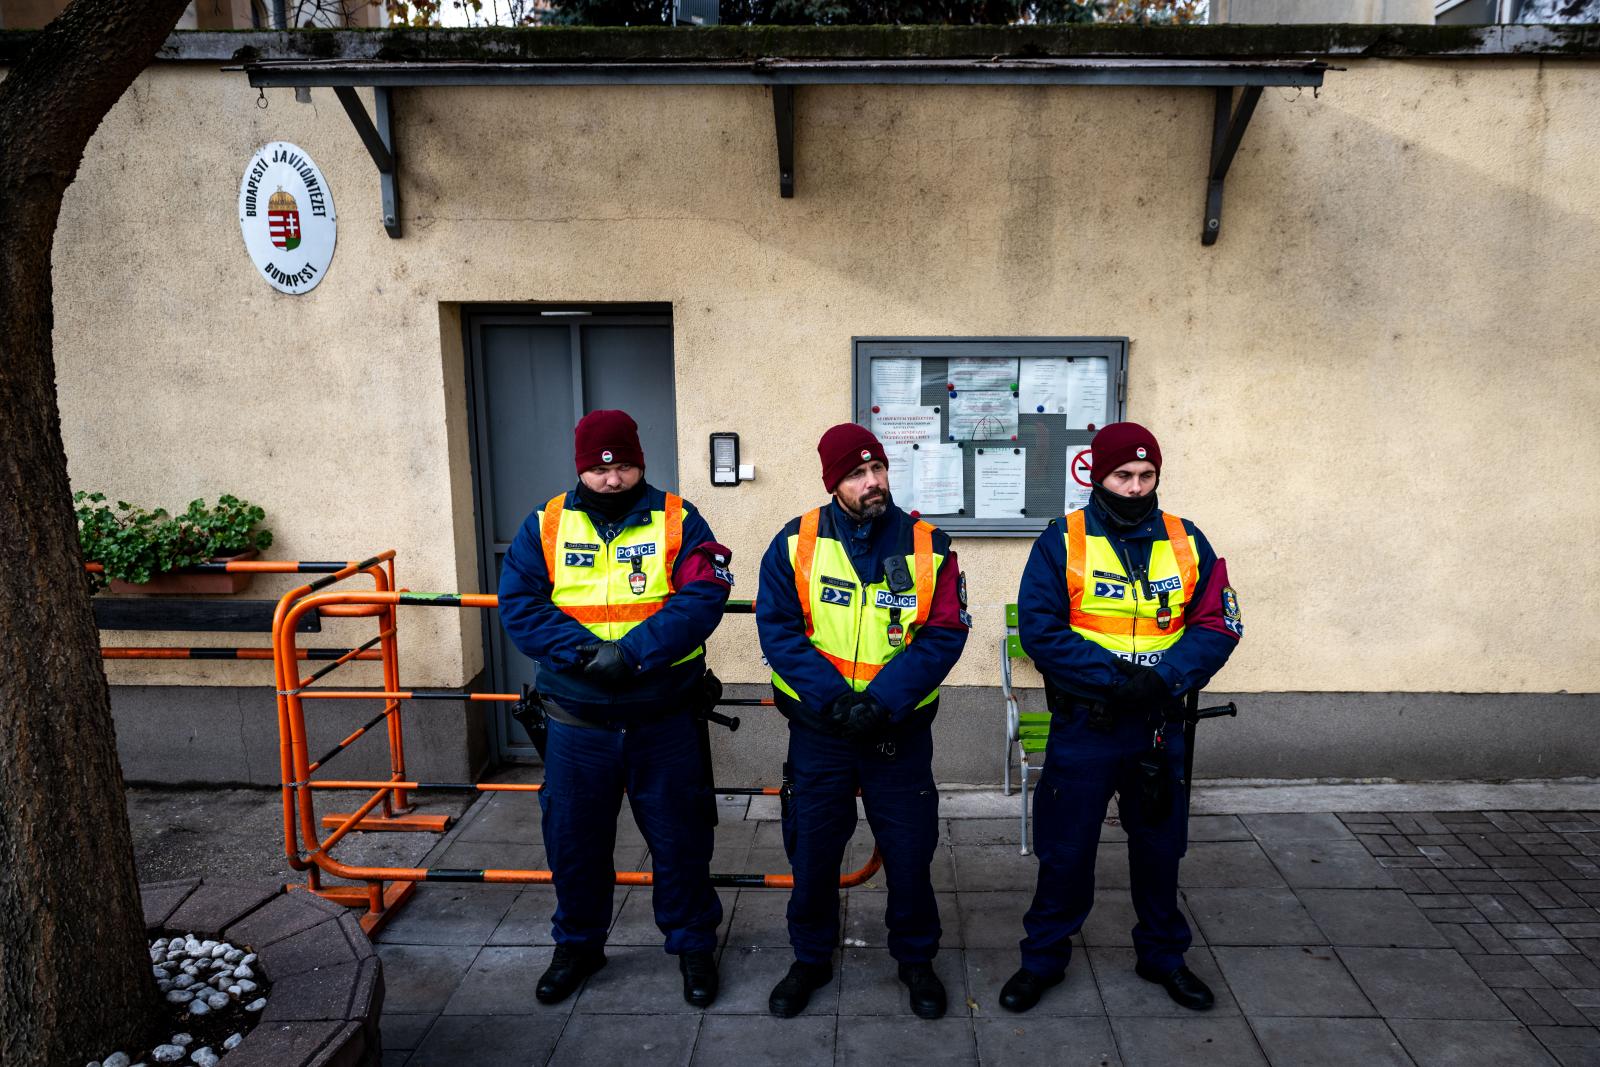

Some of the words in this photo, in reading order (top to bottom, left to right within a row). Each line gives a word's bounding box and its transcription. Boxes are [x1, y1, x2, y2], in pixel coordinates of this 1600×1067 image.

[246, 158, 268, 217] BUDAPESTI
[272, 150, 327, 218] JAVÍTÓINTÉZET
[264, 262, 318, 287] BUDAPEST
[618, 544, 655, 558] POLICE
[1150, 577, 1180, 593] OLICE
[877, 592, 916, 607] POLICE
[1138, 653, 1165, 665] PO
